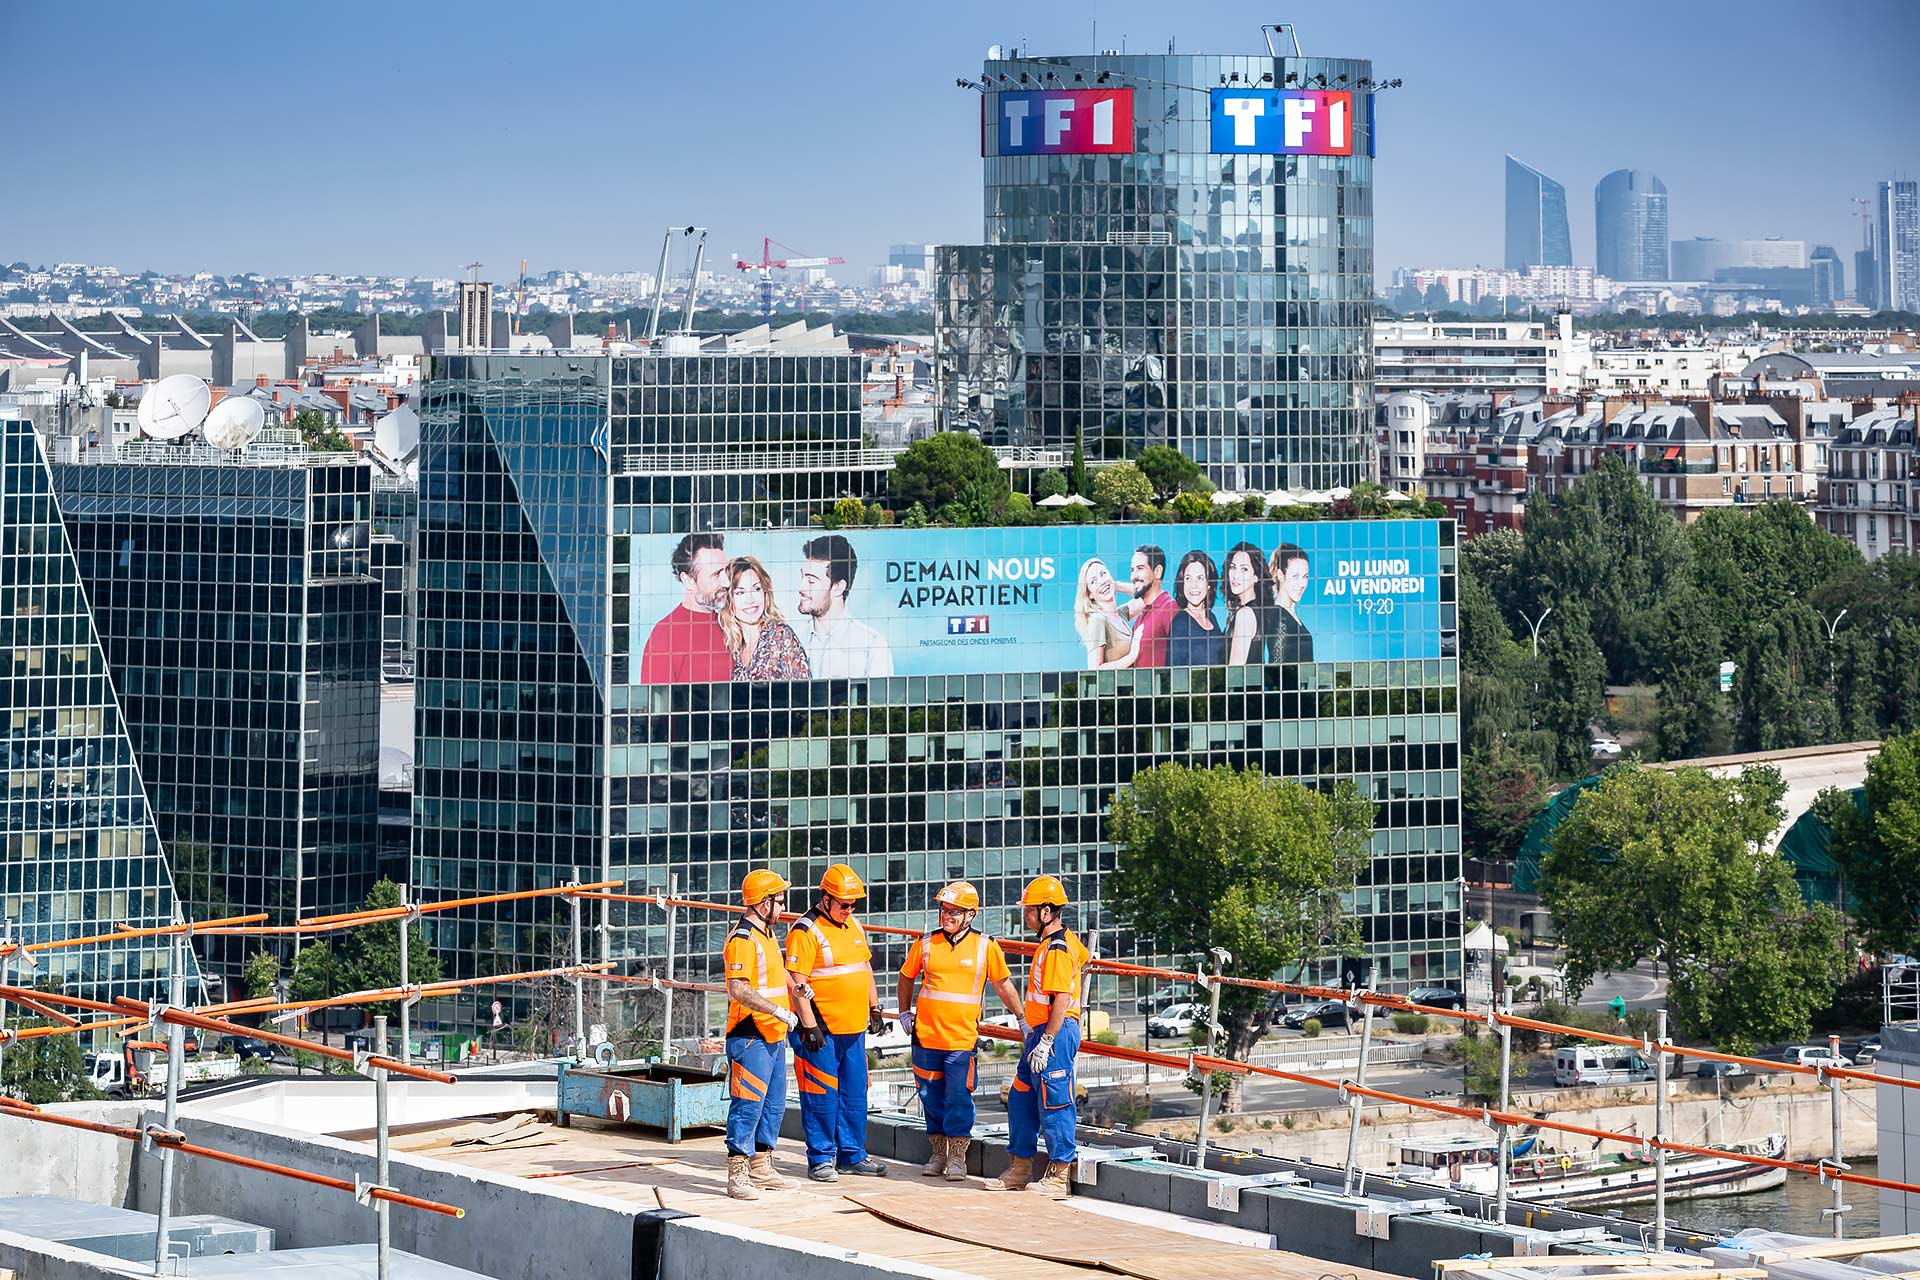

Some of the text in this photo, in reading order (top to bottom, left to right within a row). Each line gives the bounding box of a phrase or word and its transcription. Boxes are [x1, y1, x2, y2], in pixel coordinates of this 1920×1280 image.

[1005, 98, 1114, 146] TF1
[1223, 98, 1345, 148] TF1
[886, 557, 1056, 583] DEMAIN NOUS
[1338, 559, 1410, 577] DU LUNDI
[898, 583, 1043, 608] APPARTIENT
[1323, 577, 1425, 596] AU VENDREDI
[1356, 598, 1394, 615] 19:20
[949, 617, 987, 634] TF1
